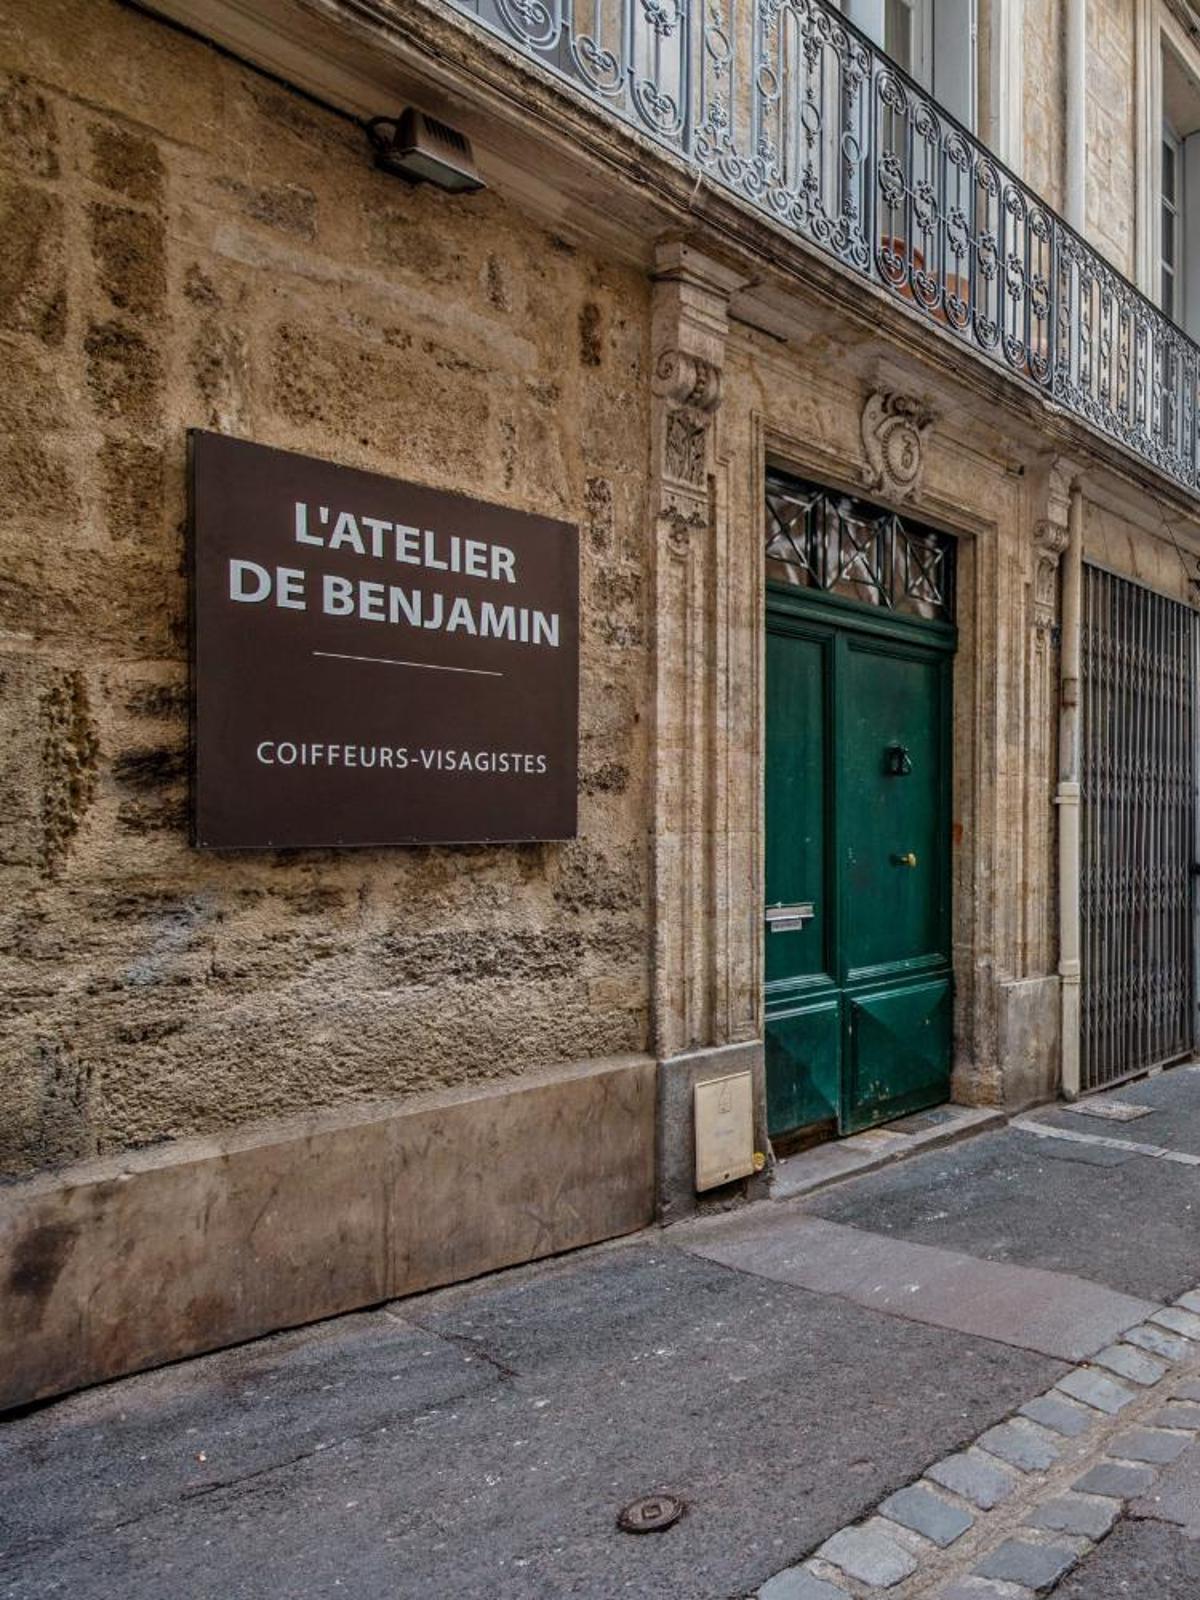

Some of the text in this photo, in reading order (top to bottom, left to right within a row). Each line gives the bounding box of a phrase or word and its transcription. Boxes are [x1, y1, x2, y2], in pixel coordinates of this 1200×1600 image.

[295, 502, 516, 583] L'ATELIER
[229, 559, 560, 647] DE BENJAMIN
[257, 742, 547, 773] COIFFEURS-VISAGISTES
